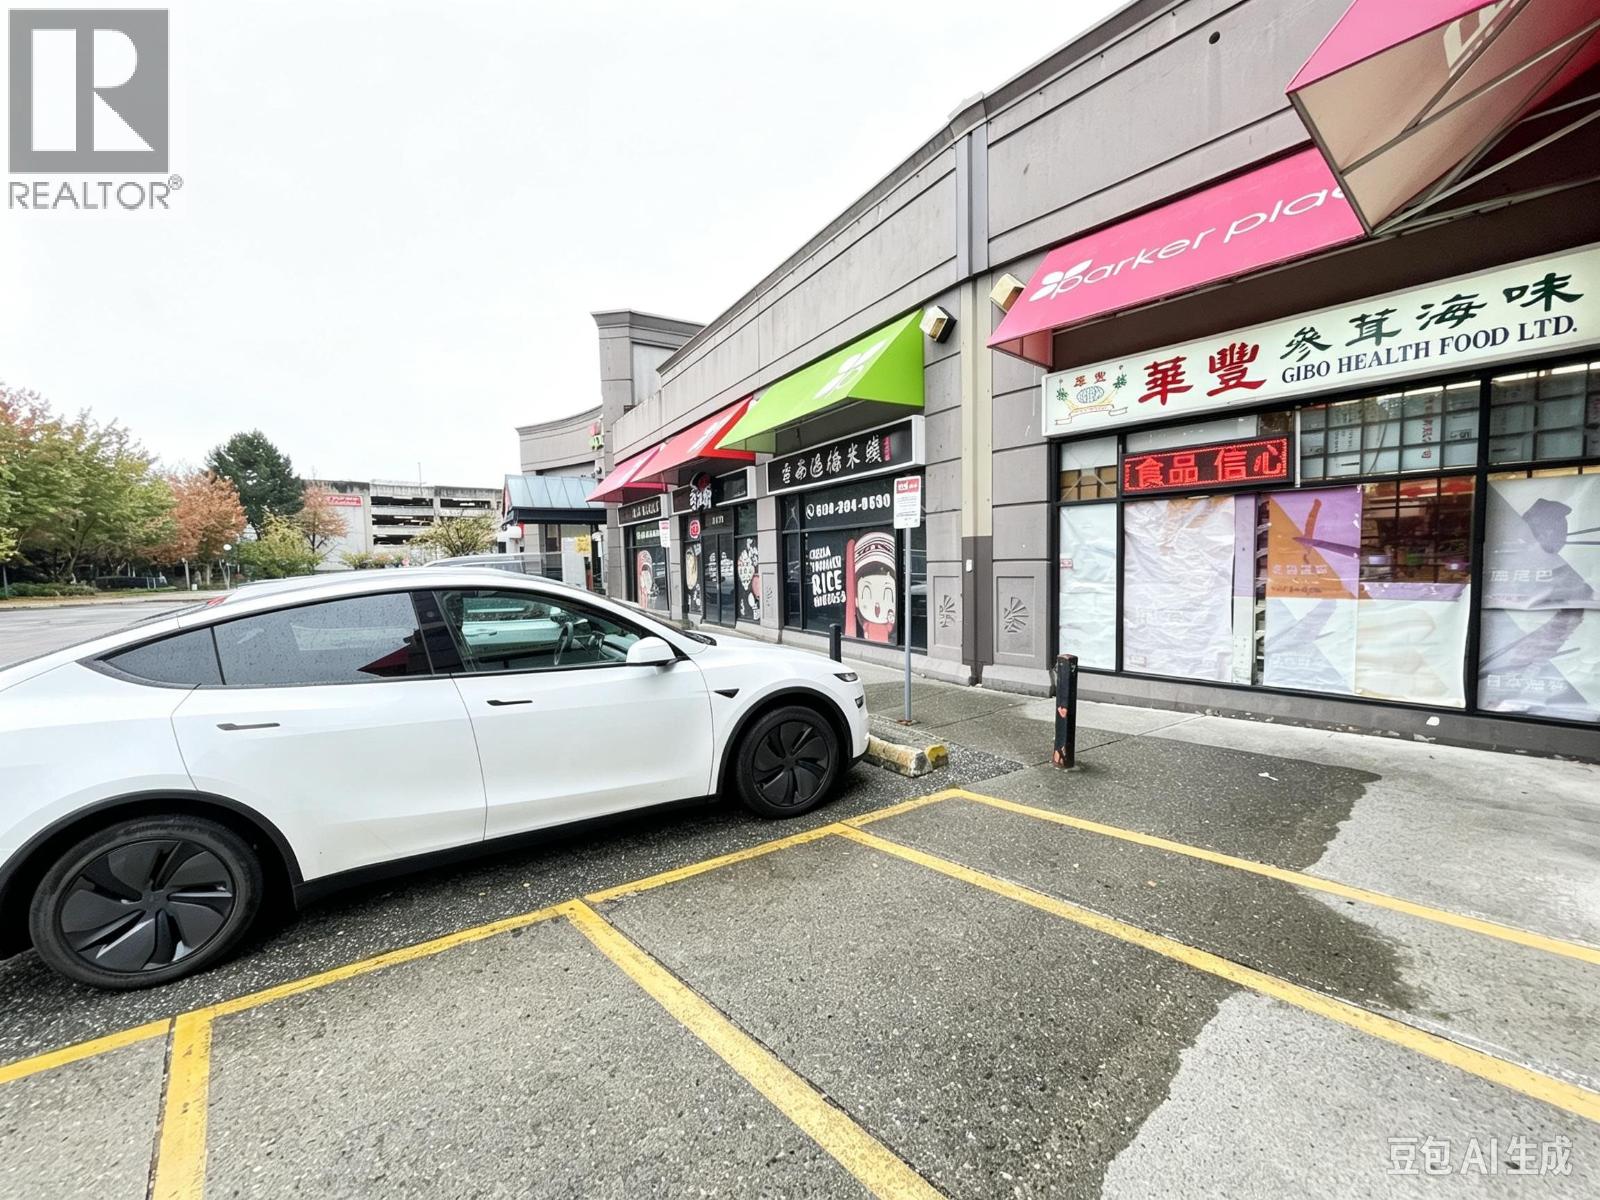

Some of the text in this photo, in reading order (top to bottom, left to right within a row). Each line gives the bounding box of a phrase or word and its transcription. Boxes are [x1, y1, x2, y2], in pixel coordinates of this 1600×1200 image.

[1049, 227, 1217, 300] parker
[1138, 342, 1267, 405] 華豐
[1281, 314, 1579, 384] GIBO HEALTH FOOD LTD.
[811, 569, 842, 596] RICE
